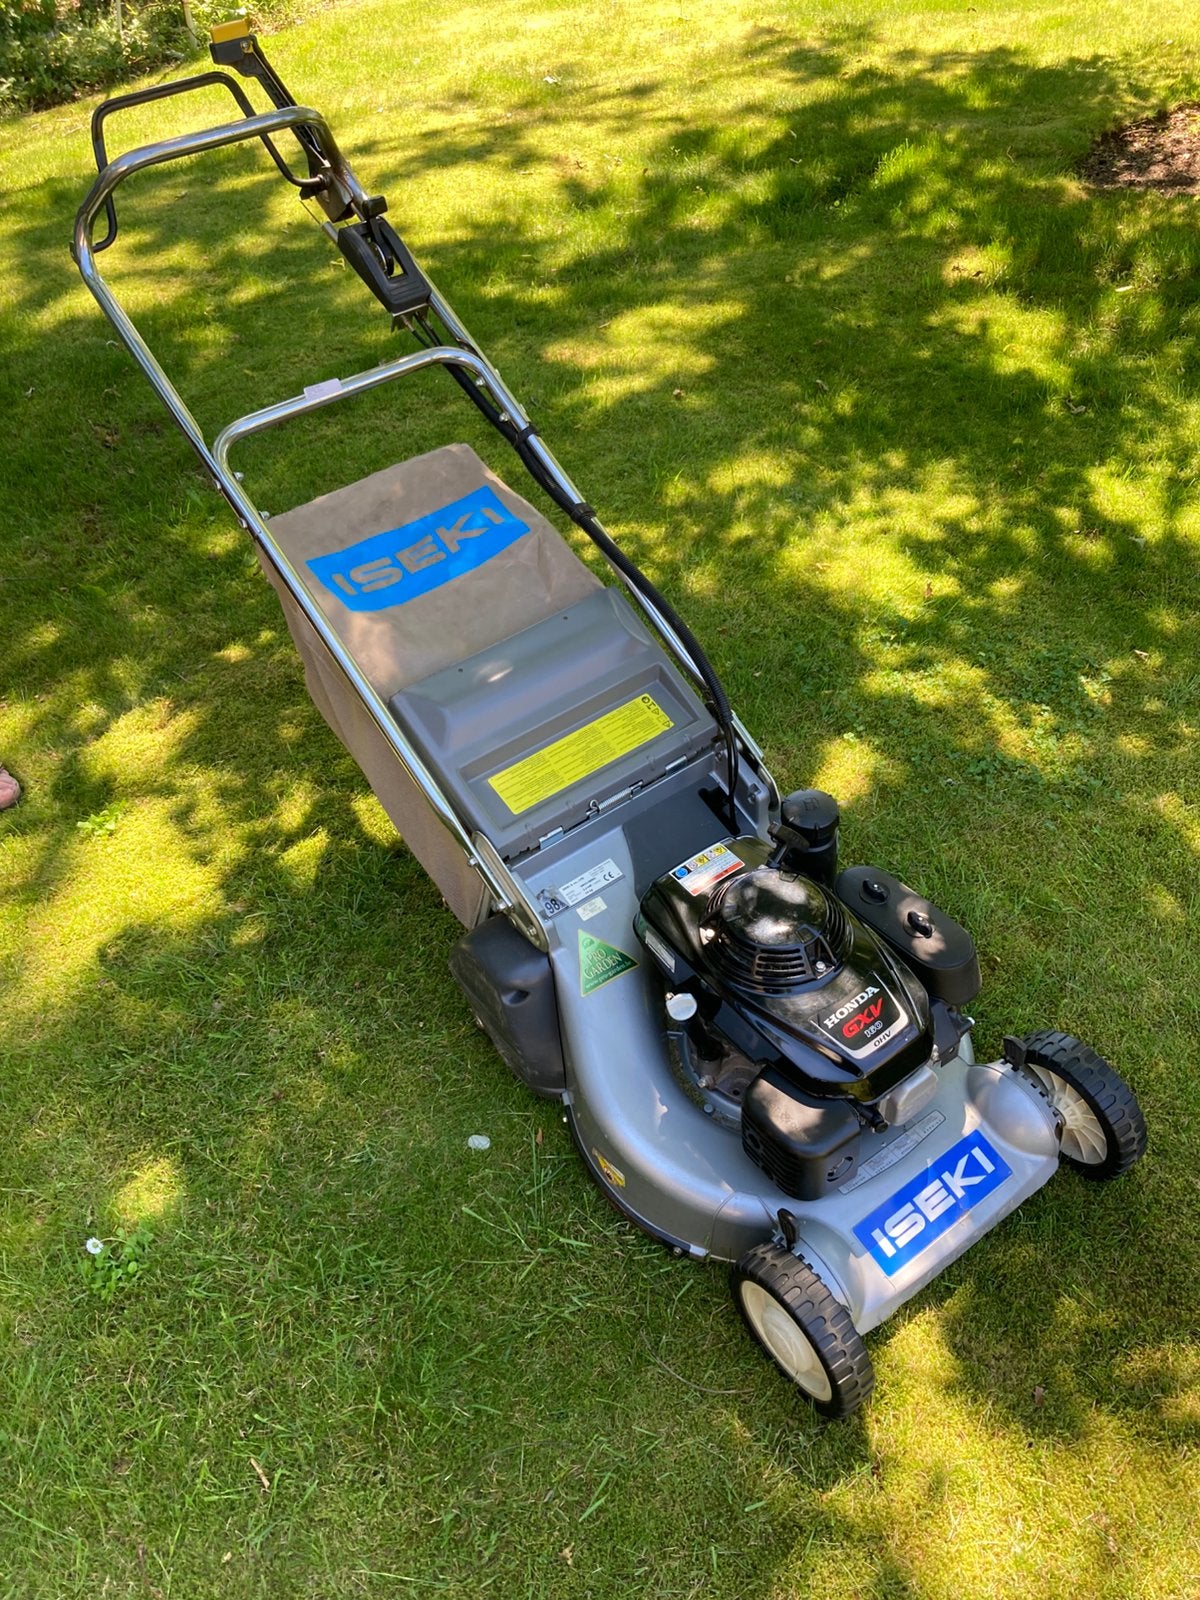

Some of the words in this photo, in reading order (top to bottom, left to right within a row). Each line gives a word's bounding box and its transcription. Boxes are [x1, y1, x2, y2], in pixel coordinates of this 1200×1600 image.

[332, 508, 504, 595] ISEKI
[544, 898, 560, 914] 98
[583, 952, 623, 979] GARDEN
[585, 948, 607, 965] PRO
[823, 985, 880, 1029] HONDA
[842, 997, 884, 1039] GXV
[864, 1020, 883, 1038] 160
[873, 1030, 892, 1047] OHV
[871, 1146, 996, 1258] ISEKI
